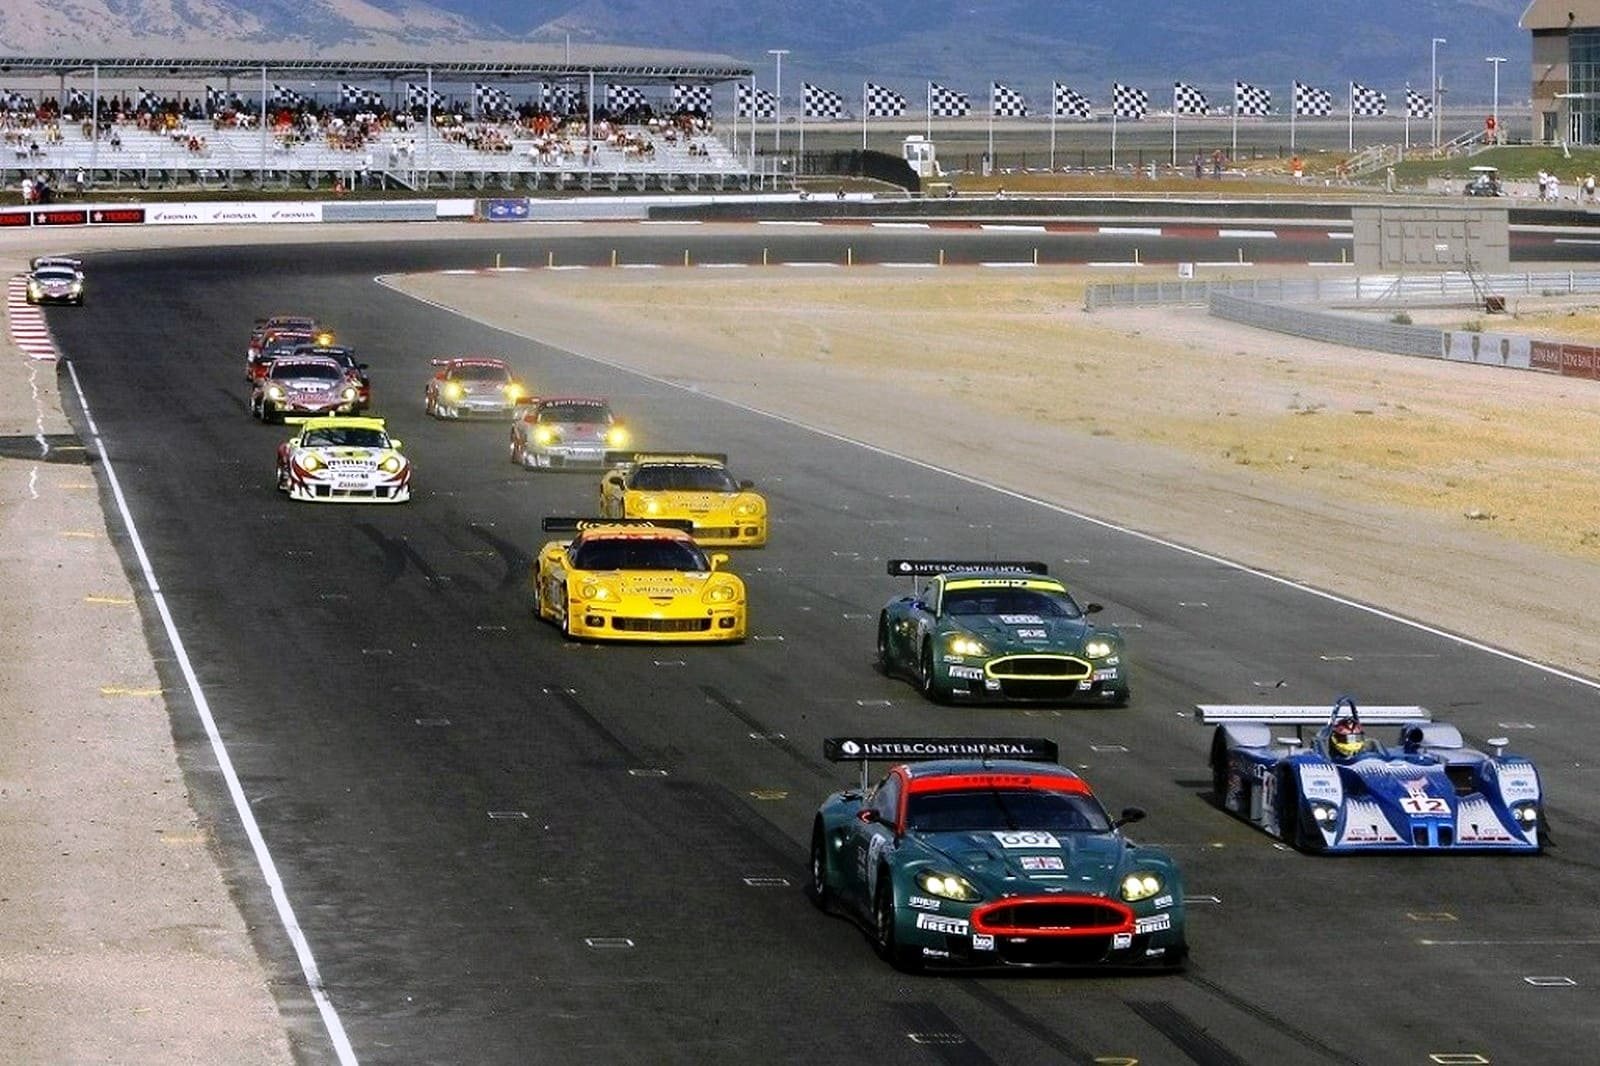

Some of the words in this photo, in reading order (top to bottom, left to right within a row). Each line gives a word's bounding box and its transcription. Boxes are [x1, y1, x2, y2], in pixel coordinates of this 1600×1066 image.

[50, 213, 82, 223] TEXACO
[105, 211, 139, 221] TEXACO
[1407, 800, 1446, 812] 12
[916, 912, 970, 935] PIRELLI
